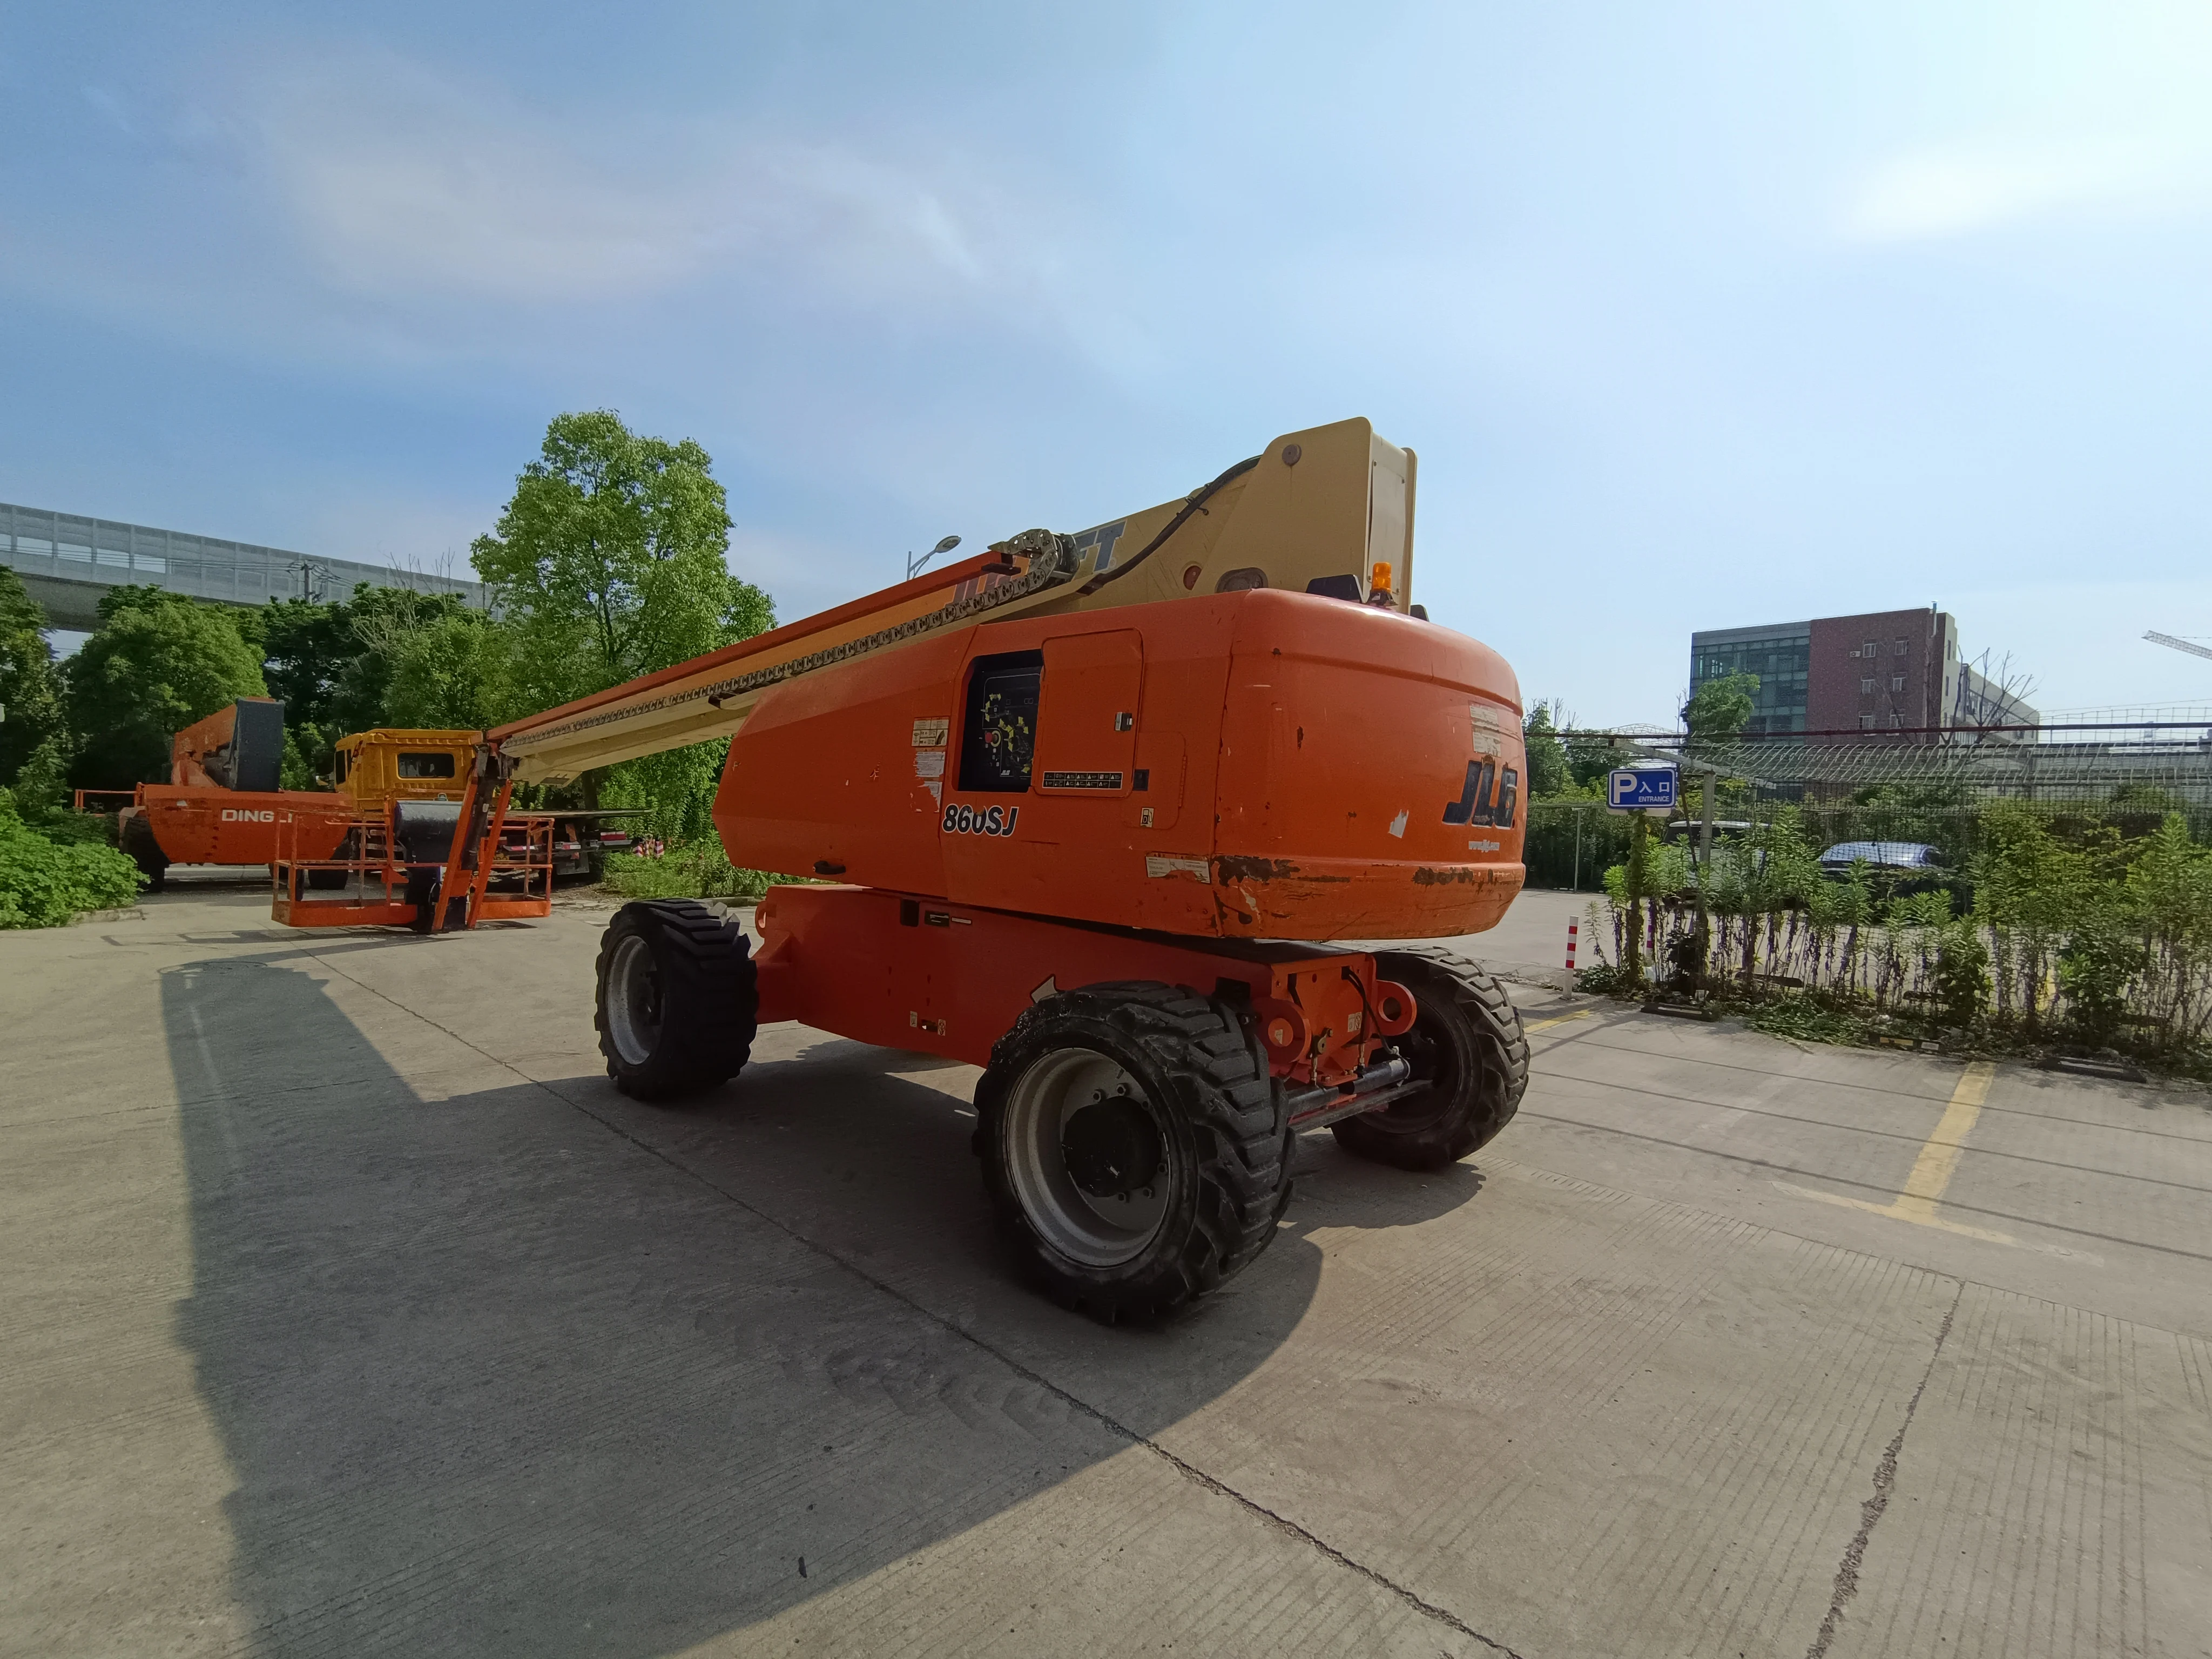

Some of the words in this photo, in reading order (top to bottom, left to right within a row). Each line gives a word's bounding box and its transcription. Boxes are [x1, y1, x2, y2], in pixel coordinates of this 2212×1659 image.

[1442, 759, 1518, 830] JLG
[1614, 773, 1637, 804] P
[1639, 781, 1670, 793] 入口
[942, 804, 1019, 837] 860SJ
